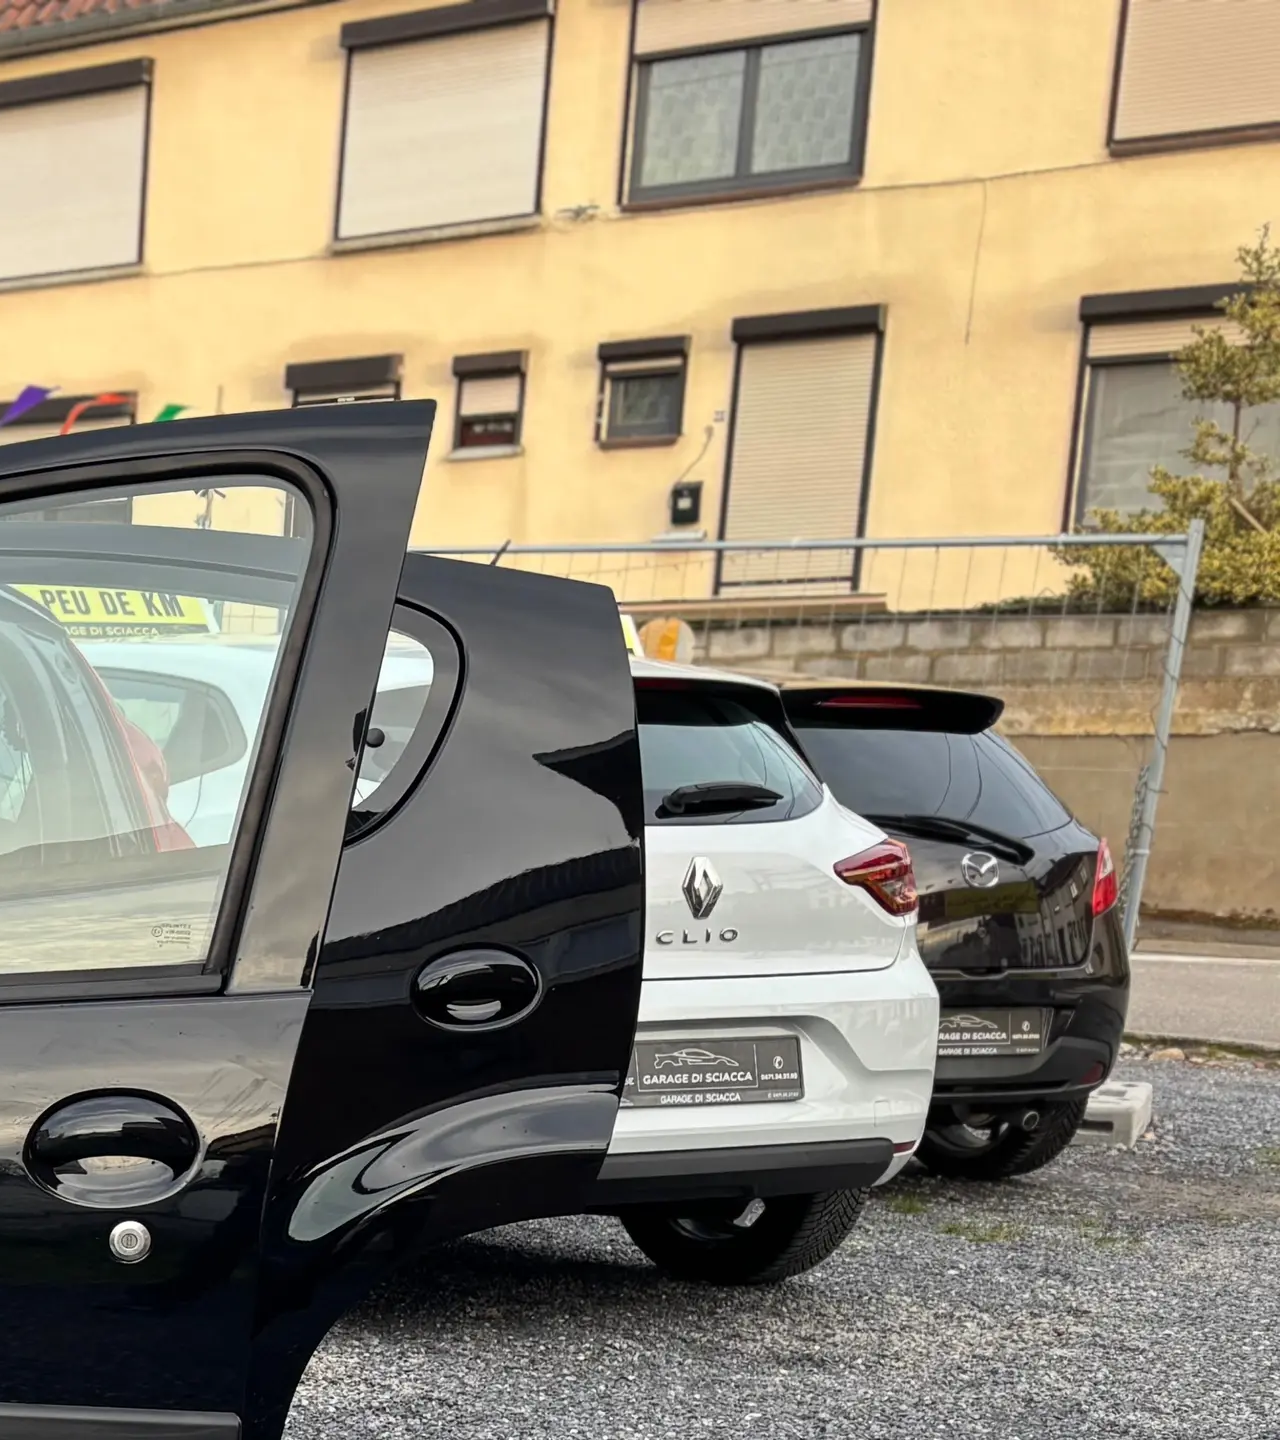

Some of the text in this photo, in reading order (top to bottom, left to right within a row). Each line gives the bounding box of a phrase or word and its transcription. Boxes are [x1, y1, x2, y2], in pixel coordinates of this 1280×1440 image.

[40, 589, 186, 618] PEU DE KM
[89, 626, 102, 636] DI
[105, 626, 161, 636] SCIACCA
[656, 927, 739, 945] CLIO
[972, 1031, 1008, 1040] SCIACCA
[643, 1074, 689, 1085] GARAGE
[691, 1073, 703, 1083] DI
[705, 1071, 753, 1083] SCIACCA
[695, 1093, 704, 1103] DI
[706, 1092, 742, 1102] SCIACCA
